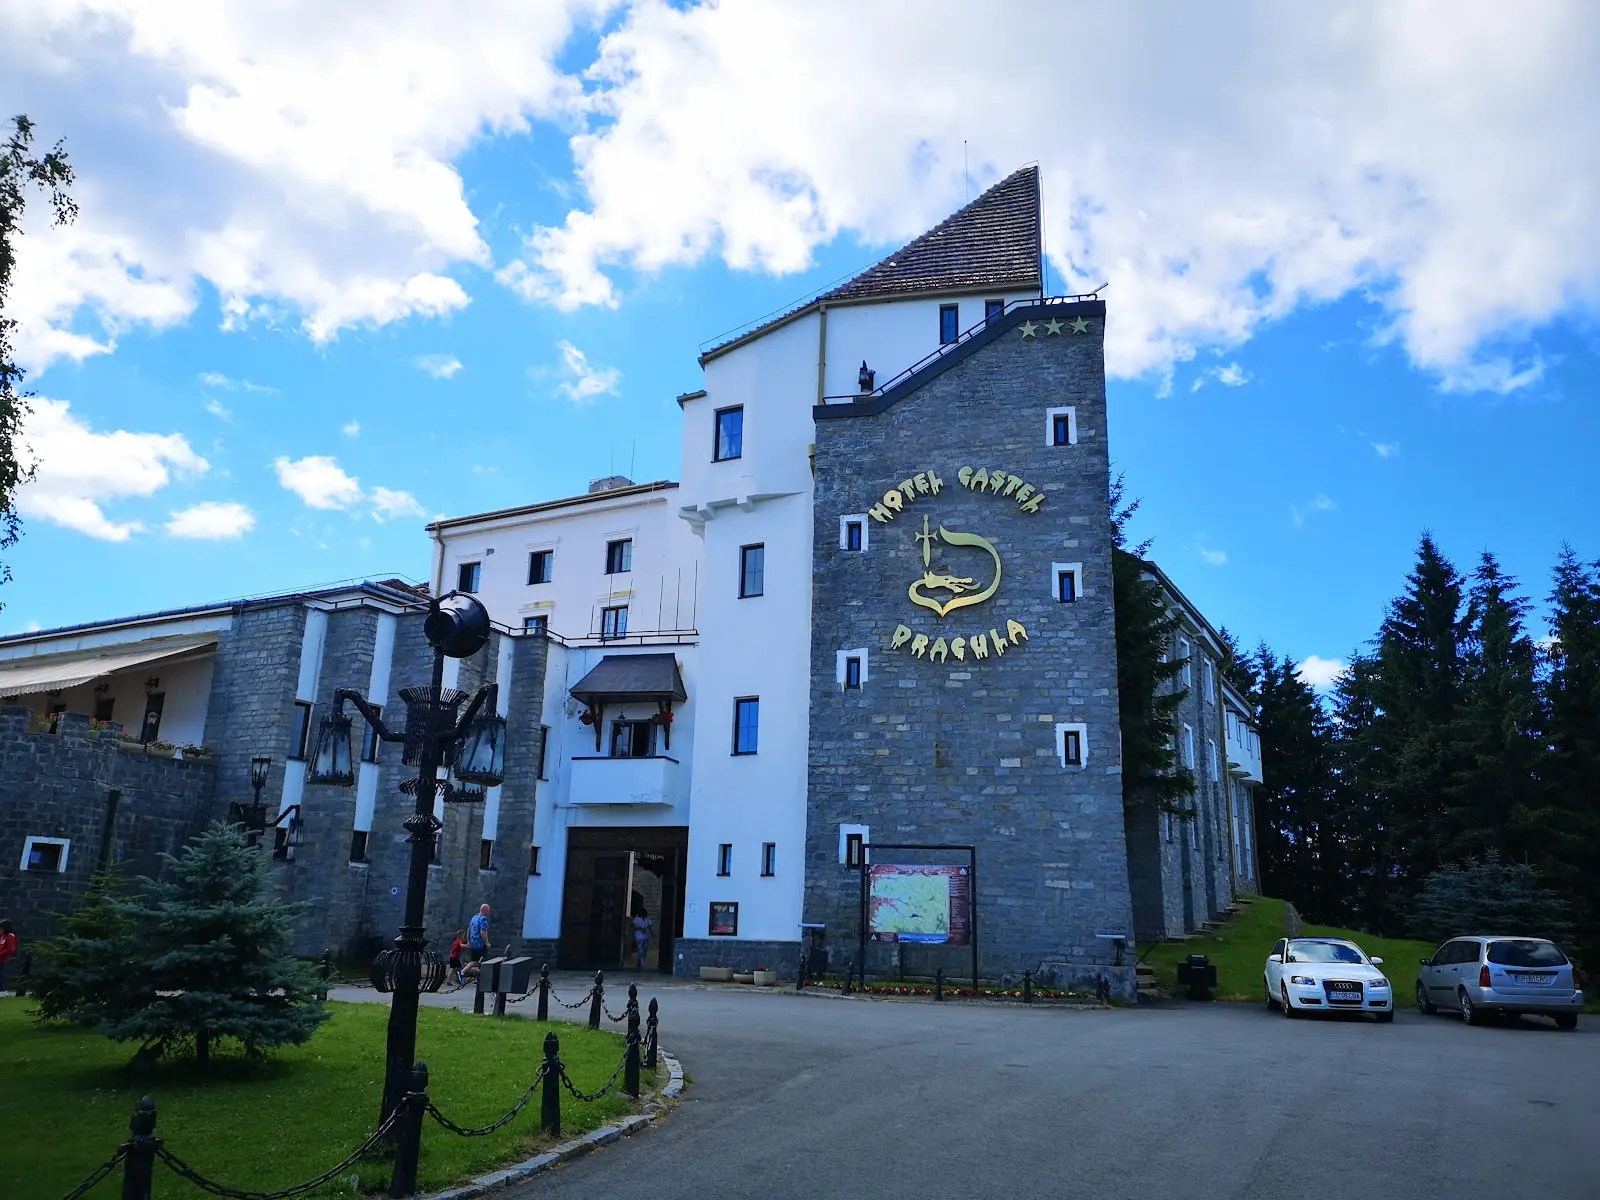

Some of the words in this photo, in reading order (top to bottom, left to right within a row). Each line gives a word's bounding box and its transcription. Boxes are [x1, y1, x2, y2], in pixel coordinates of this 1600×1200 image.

[868, 470, 944, 523] HOTEL
[958, 465, 1046, 514] CASTEL
[891, 618, 1029, 664] DRACULA
